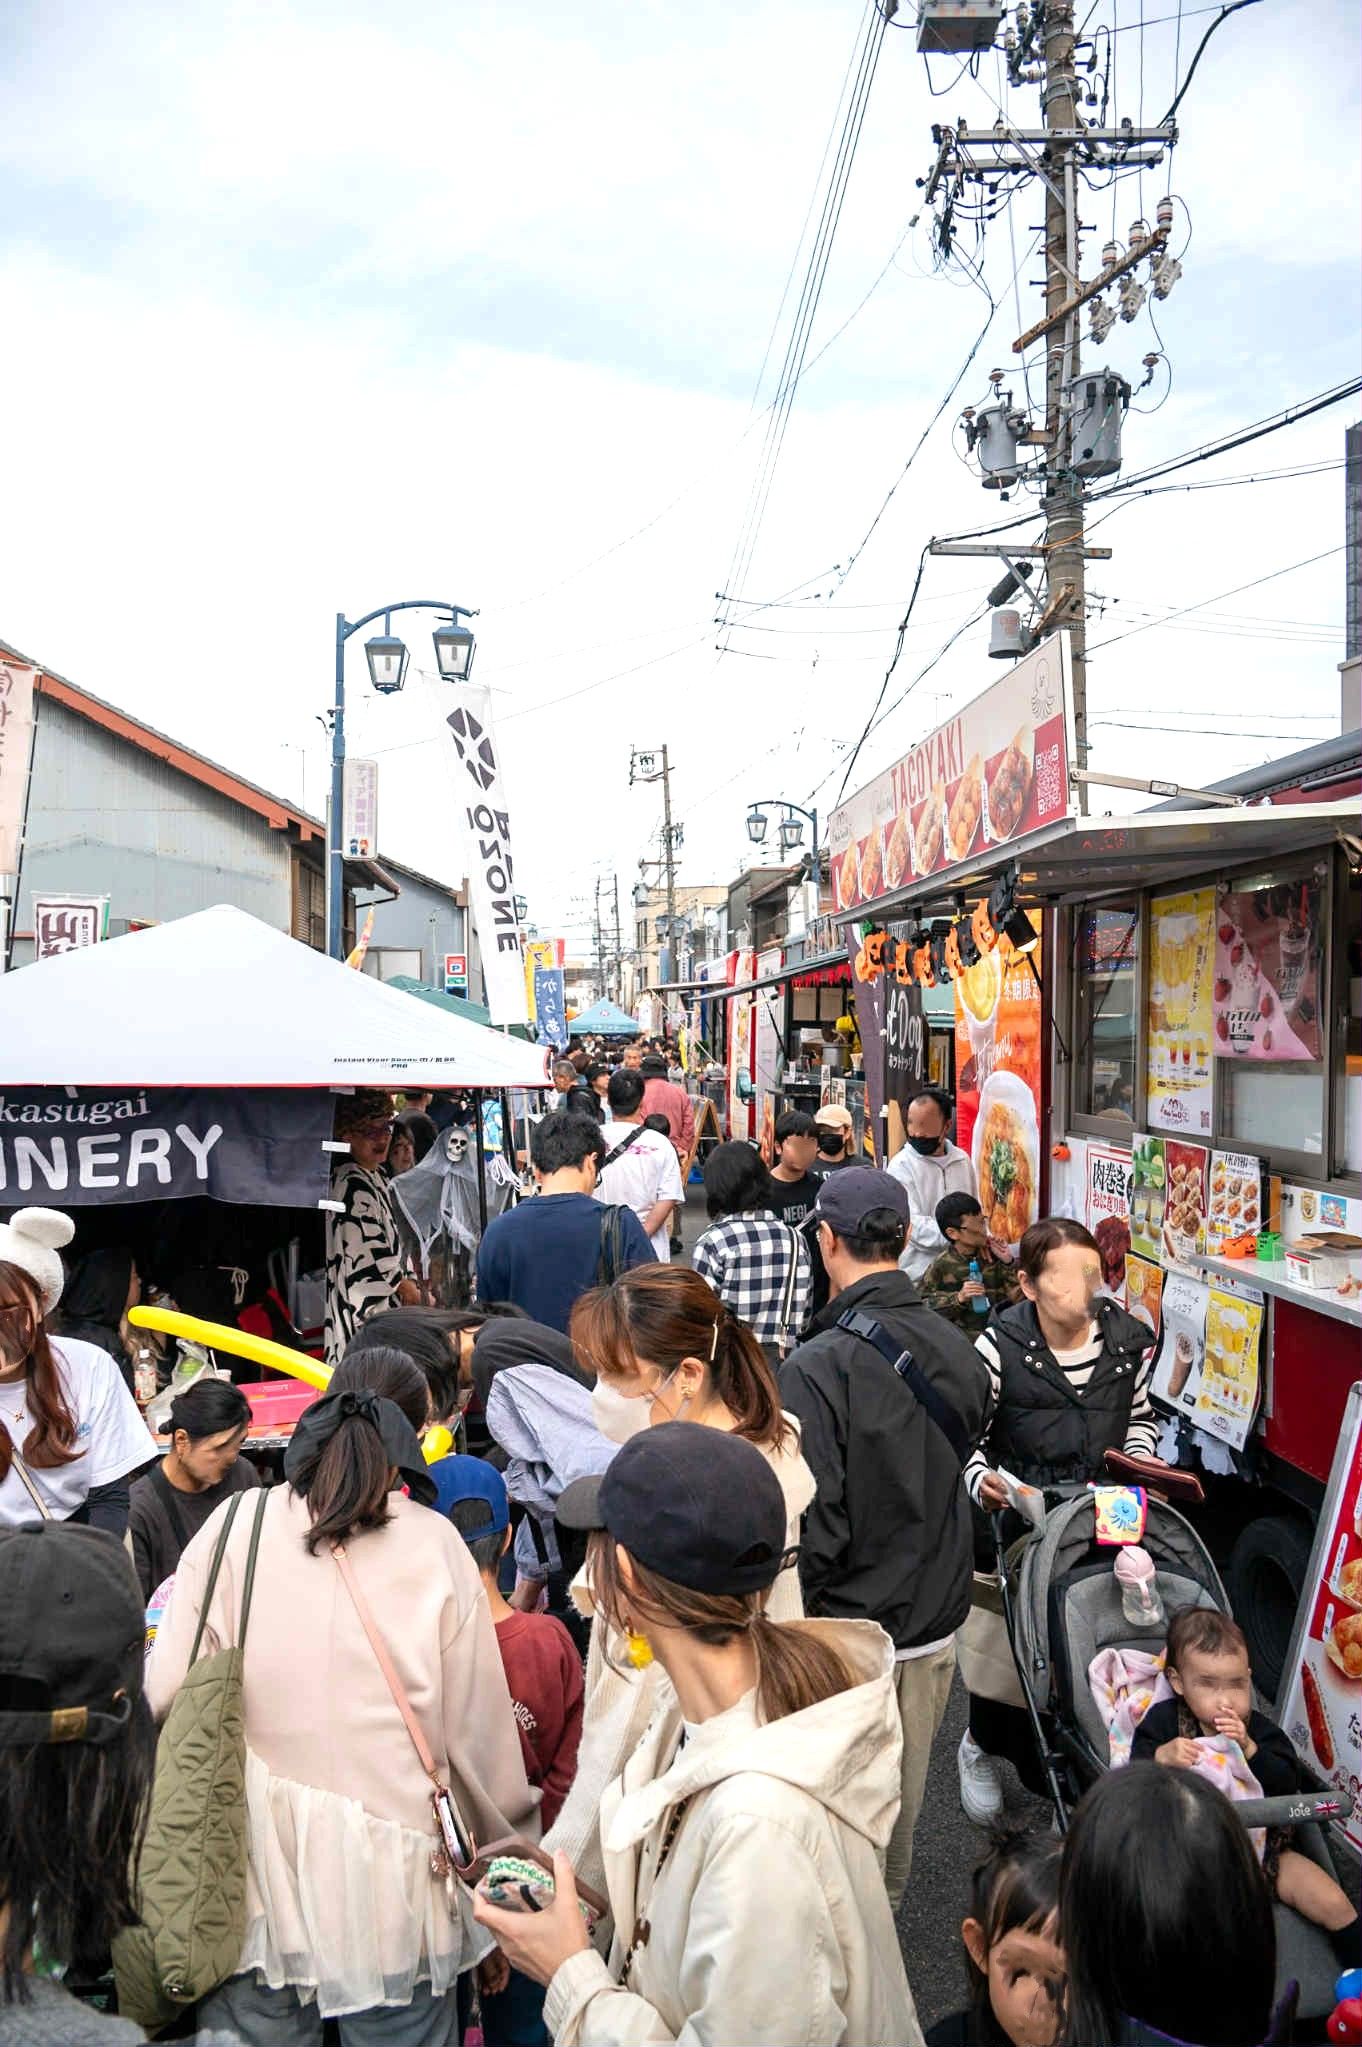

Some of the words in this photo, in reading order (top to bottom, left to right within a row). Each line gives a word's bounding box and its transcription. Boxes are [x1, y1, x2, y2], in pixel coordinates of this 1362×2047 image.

[890, 718, 964, 817] TACOYAKI
[898, 990, 924, 1081] Dog
[1289, 1802, 1312, 1818] Joie
